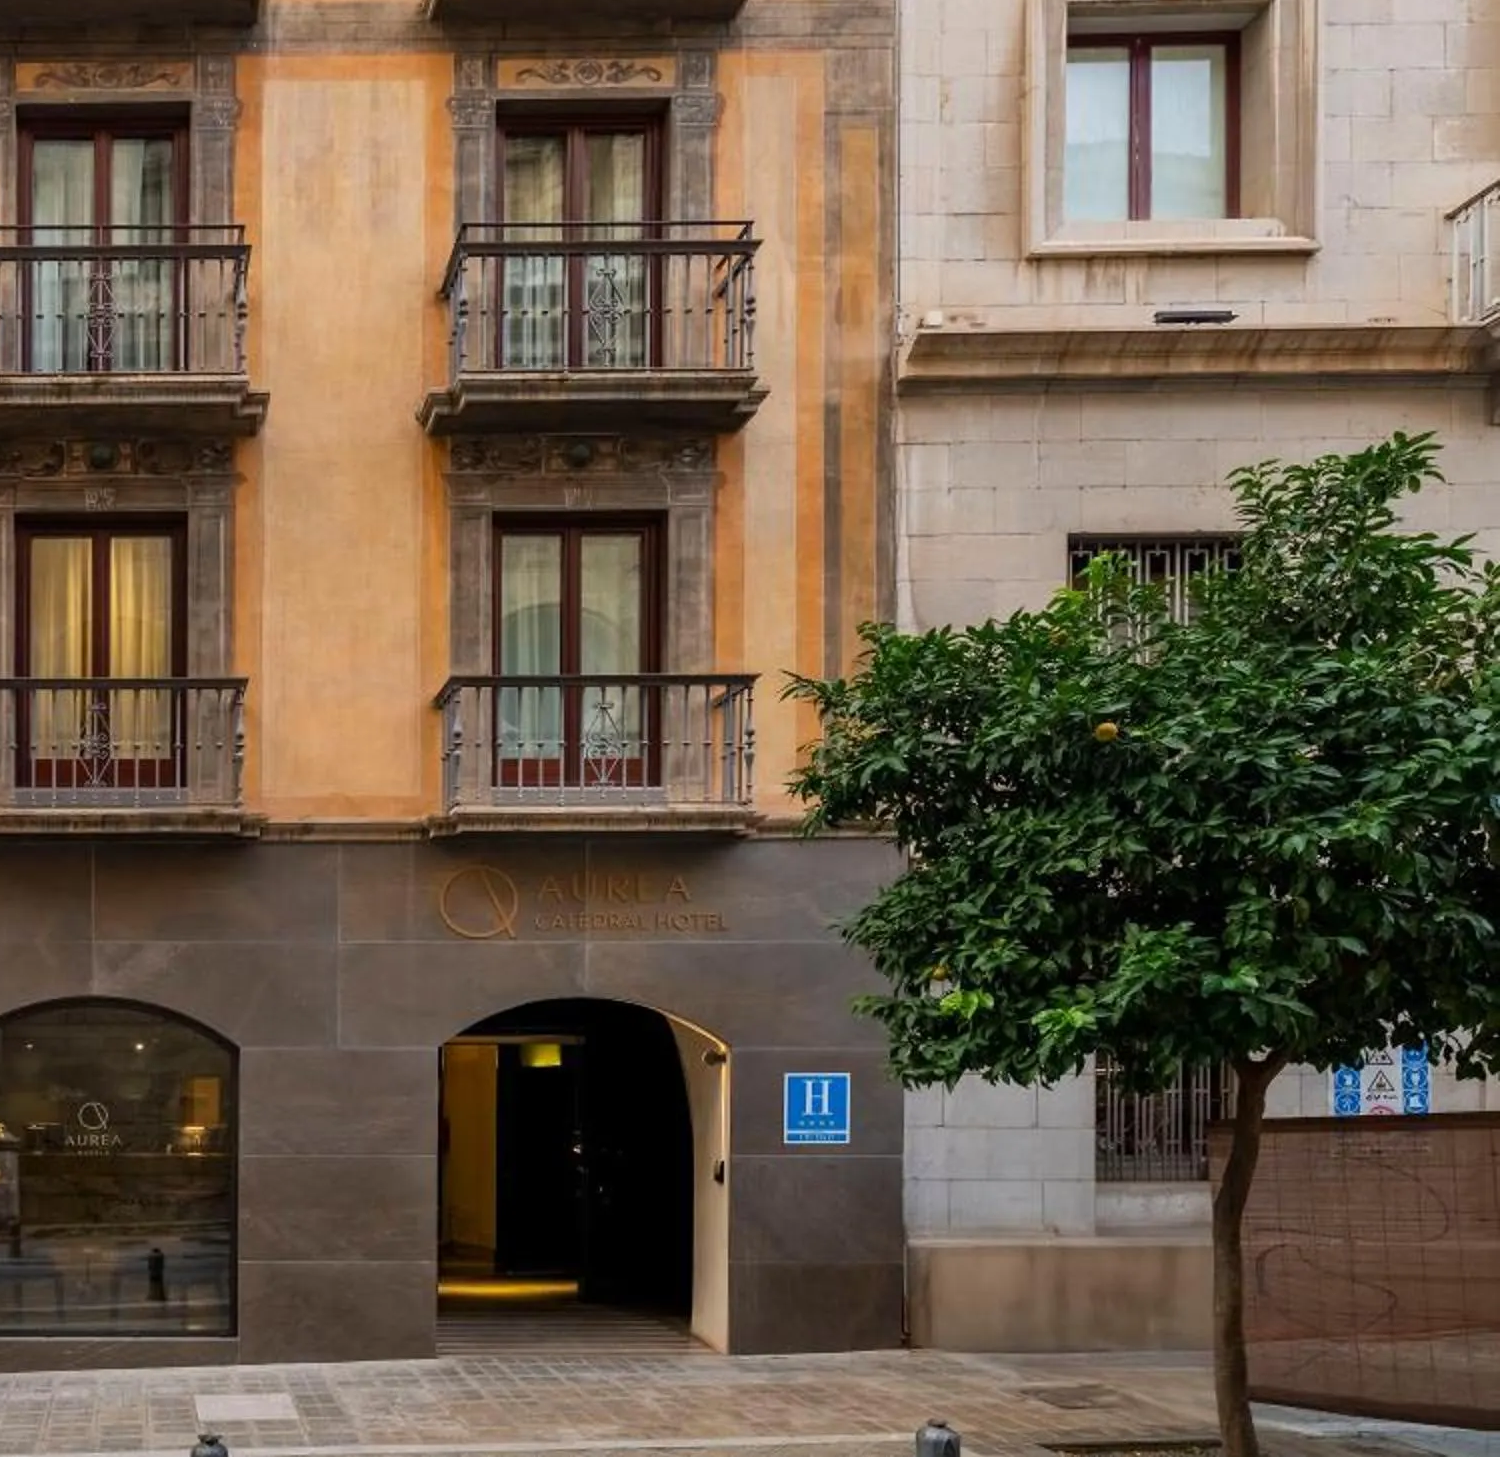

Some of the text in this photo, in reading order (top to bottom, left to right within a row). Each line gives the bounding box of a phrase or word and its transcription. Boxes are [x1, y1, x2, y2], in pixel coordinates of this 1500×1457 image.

[655, 910, 730, 933] HOTEL
[803, 1079, 833, 1116] H
[64, 1134, 122, 1146] AUREA
